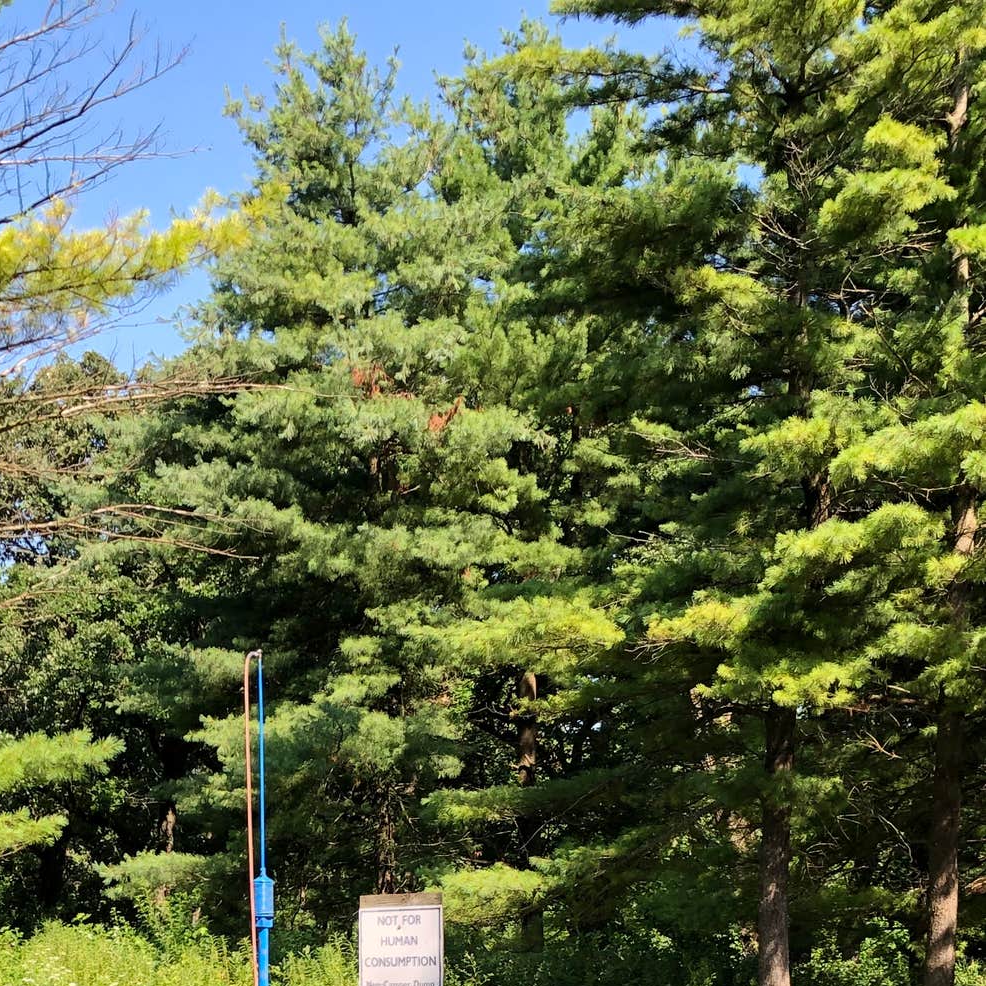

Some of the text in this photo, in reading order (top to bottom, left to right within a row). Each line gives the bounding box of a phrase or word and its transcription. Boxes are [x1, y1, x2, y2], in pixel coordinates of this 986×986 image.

[377, 914, 421, 926] NOT FOR
[380, 935, 418, 946] HUMAN
[365, 956, 437, 967] CONSUMPTION
